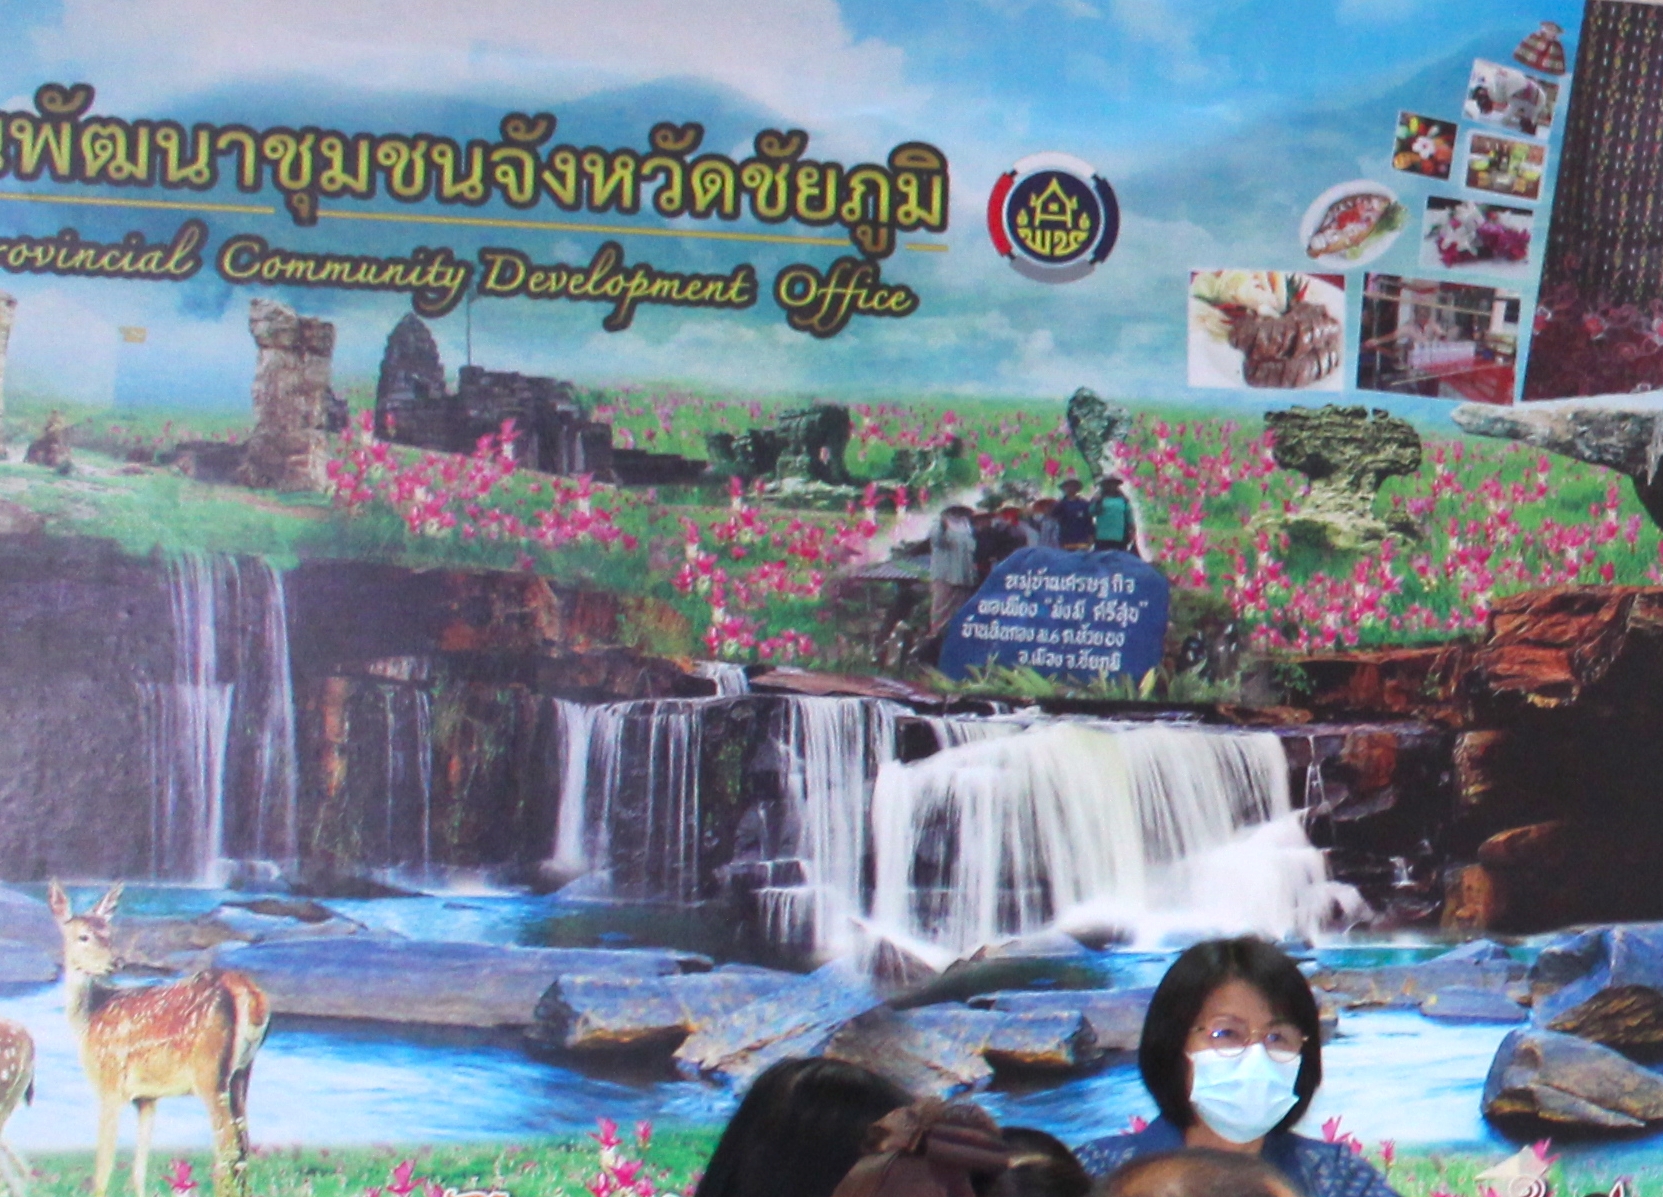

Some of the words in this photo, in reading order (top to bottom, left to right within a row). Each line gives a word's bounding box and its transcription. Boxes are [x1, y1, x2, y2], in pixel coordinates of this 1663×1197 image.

[0, 84, 949, 256] พัฒนาชุมชนจังหวัดชัยภูมิ
[222, 240, 468, 314] Community
[482, 251, 751, 328] Development
[777, 264, 914, 334] Office
